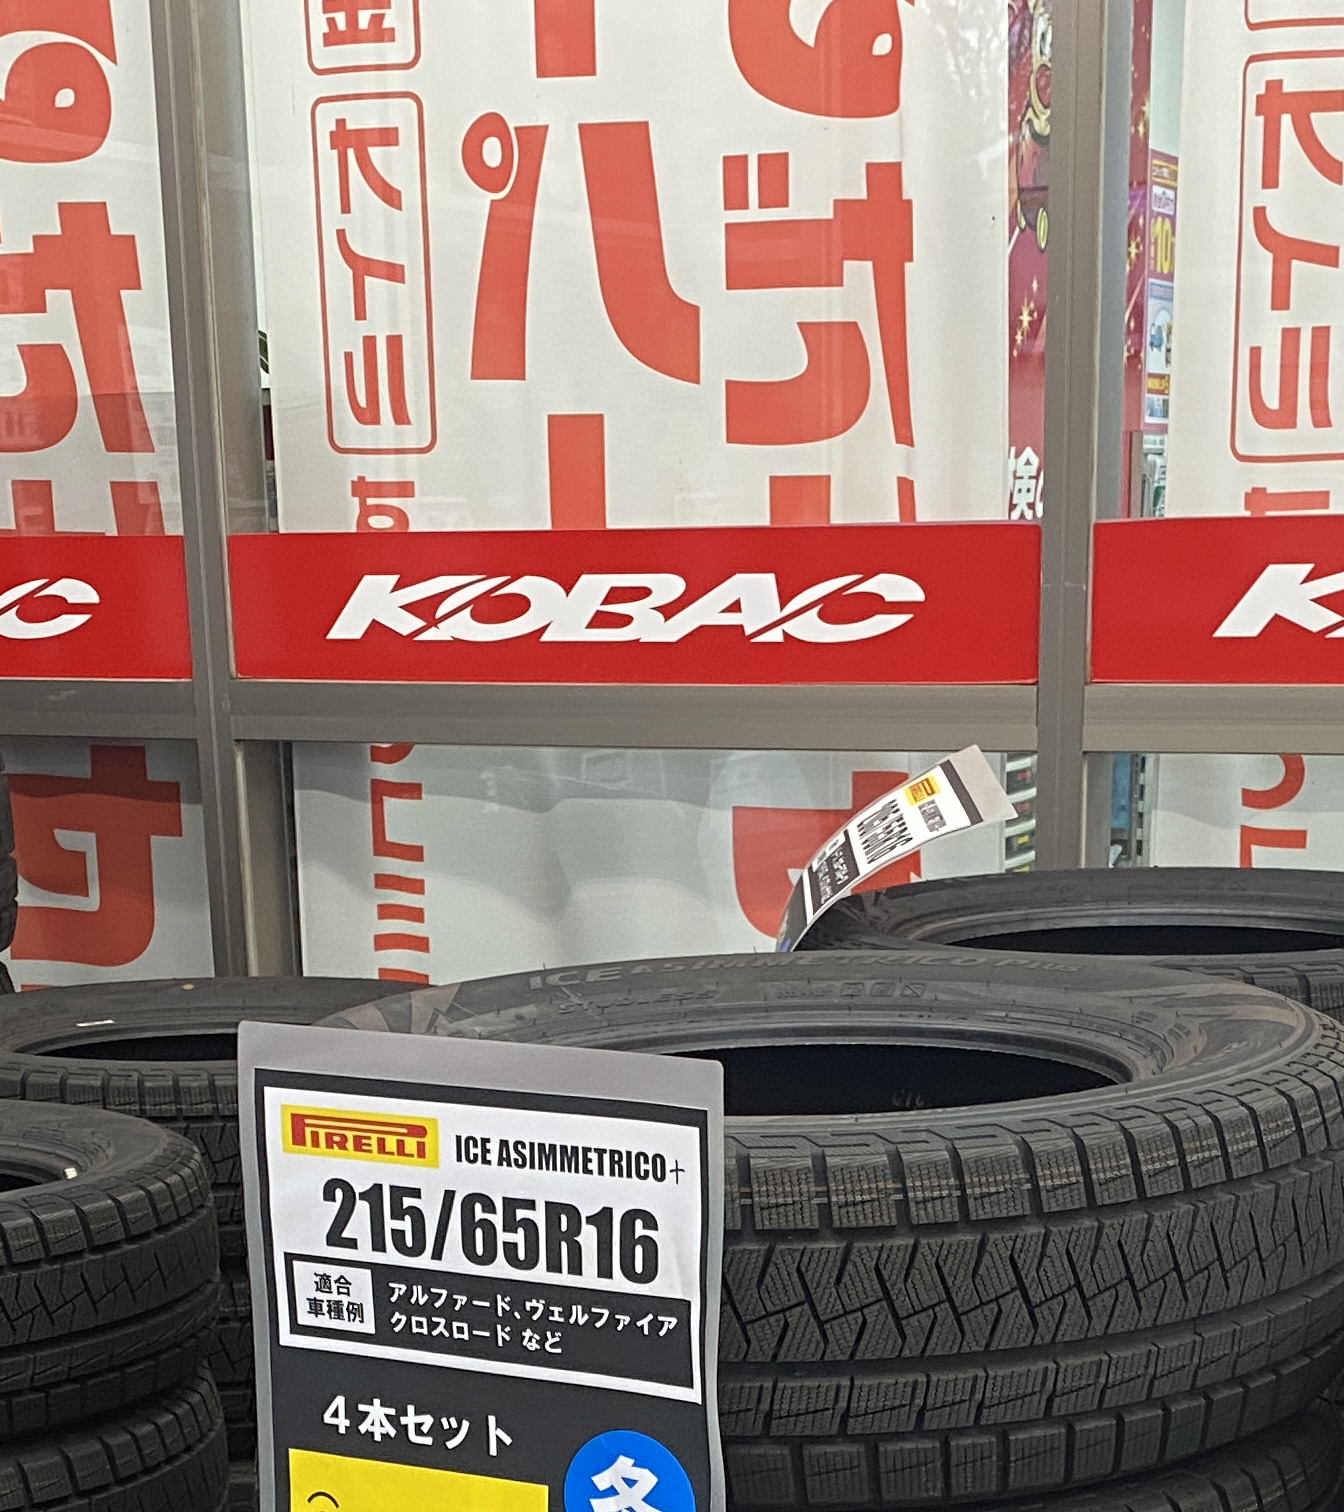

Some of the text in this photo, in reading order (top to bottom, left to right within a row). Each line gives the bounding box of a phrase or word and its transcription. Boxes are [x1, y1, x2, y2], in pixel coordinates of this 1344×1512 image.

[326, 573, 926, 643] KOBAC
[290, 1112, 428, 1160] PIRELLI
[455, 1134, 493, 1166] ICE
[322, 1176, 661, 1285] 215/65R16
[306, 1297, 366, 1325] 車種例
[312, 1271, 353, 1297] 適合
[389, 1311, 563, 1355] クロスロード など
[322, 1393, 515, 1457] 4本セット
